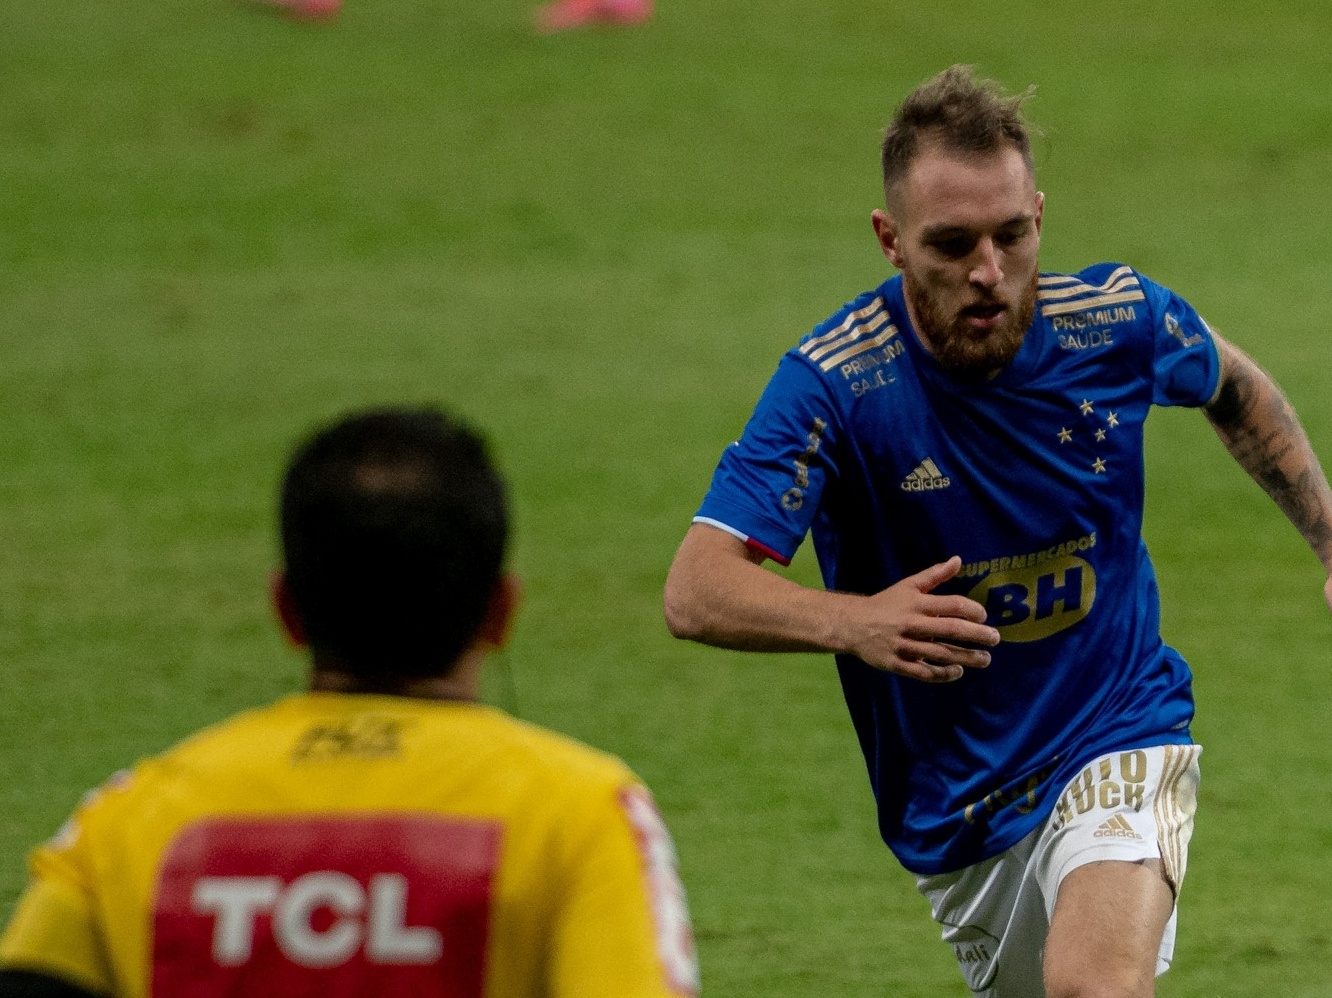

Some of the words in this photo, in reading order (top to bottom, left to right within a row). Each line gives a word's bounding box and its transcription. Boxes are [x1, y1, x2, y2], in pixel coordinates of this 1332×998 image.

[901, 477, 950, 491] adidas
[985, 566, 1083, 627] BH
[1093, 828, 1143, 840] adidas
[191, 871, 444, 968] TCL
